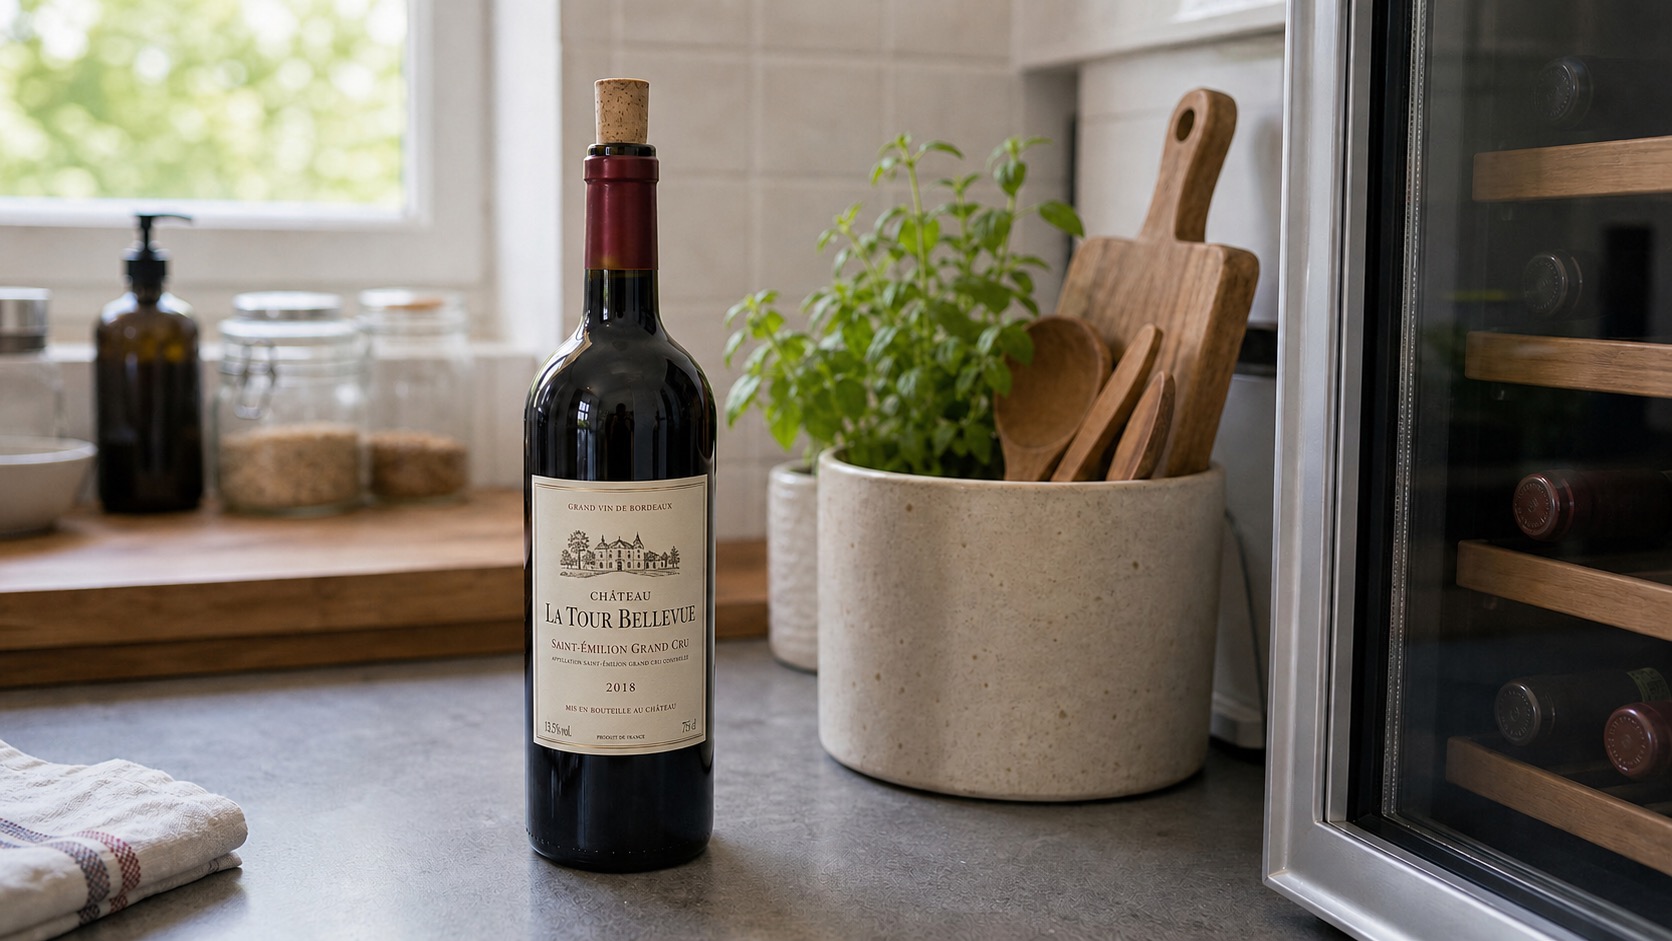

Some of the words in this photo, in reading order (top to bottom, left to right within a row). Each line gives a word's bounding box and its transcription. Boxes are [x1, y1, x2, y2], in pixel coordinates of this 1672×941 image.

[568, 502, 596, 512] GRAND
[630, 502, 672, 512] BORDEAUX
[590, 590, 651, 601] CHÂTEAU
[545, 602, 562, 626] LA
[566, 606, 612, 628] TOUR
[618, 605, 696, 628] BELLEVUE
[551, 638, 628, 655] SAINT-ÉMILION
[631, 642, 668, 654] GRAND
[671, 638, 690, 650] CRU
[606, 682, 636, 692] 2018
[565, 704, 578, 712] MIS
[590, 706, 632, 714] BOUTEILLE
[645, 702, 676, 713] CHÂTEAU
